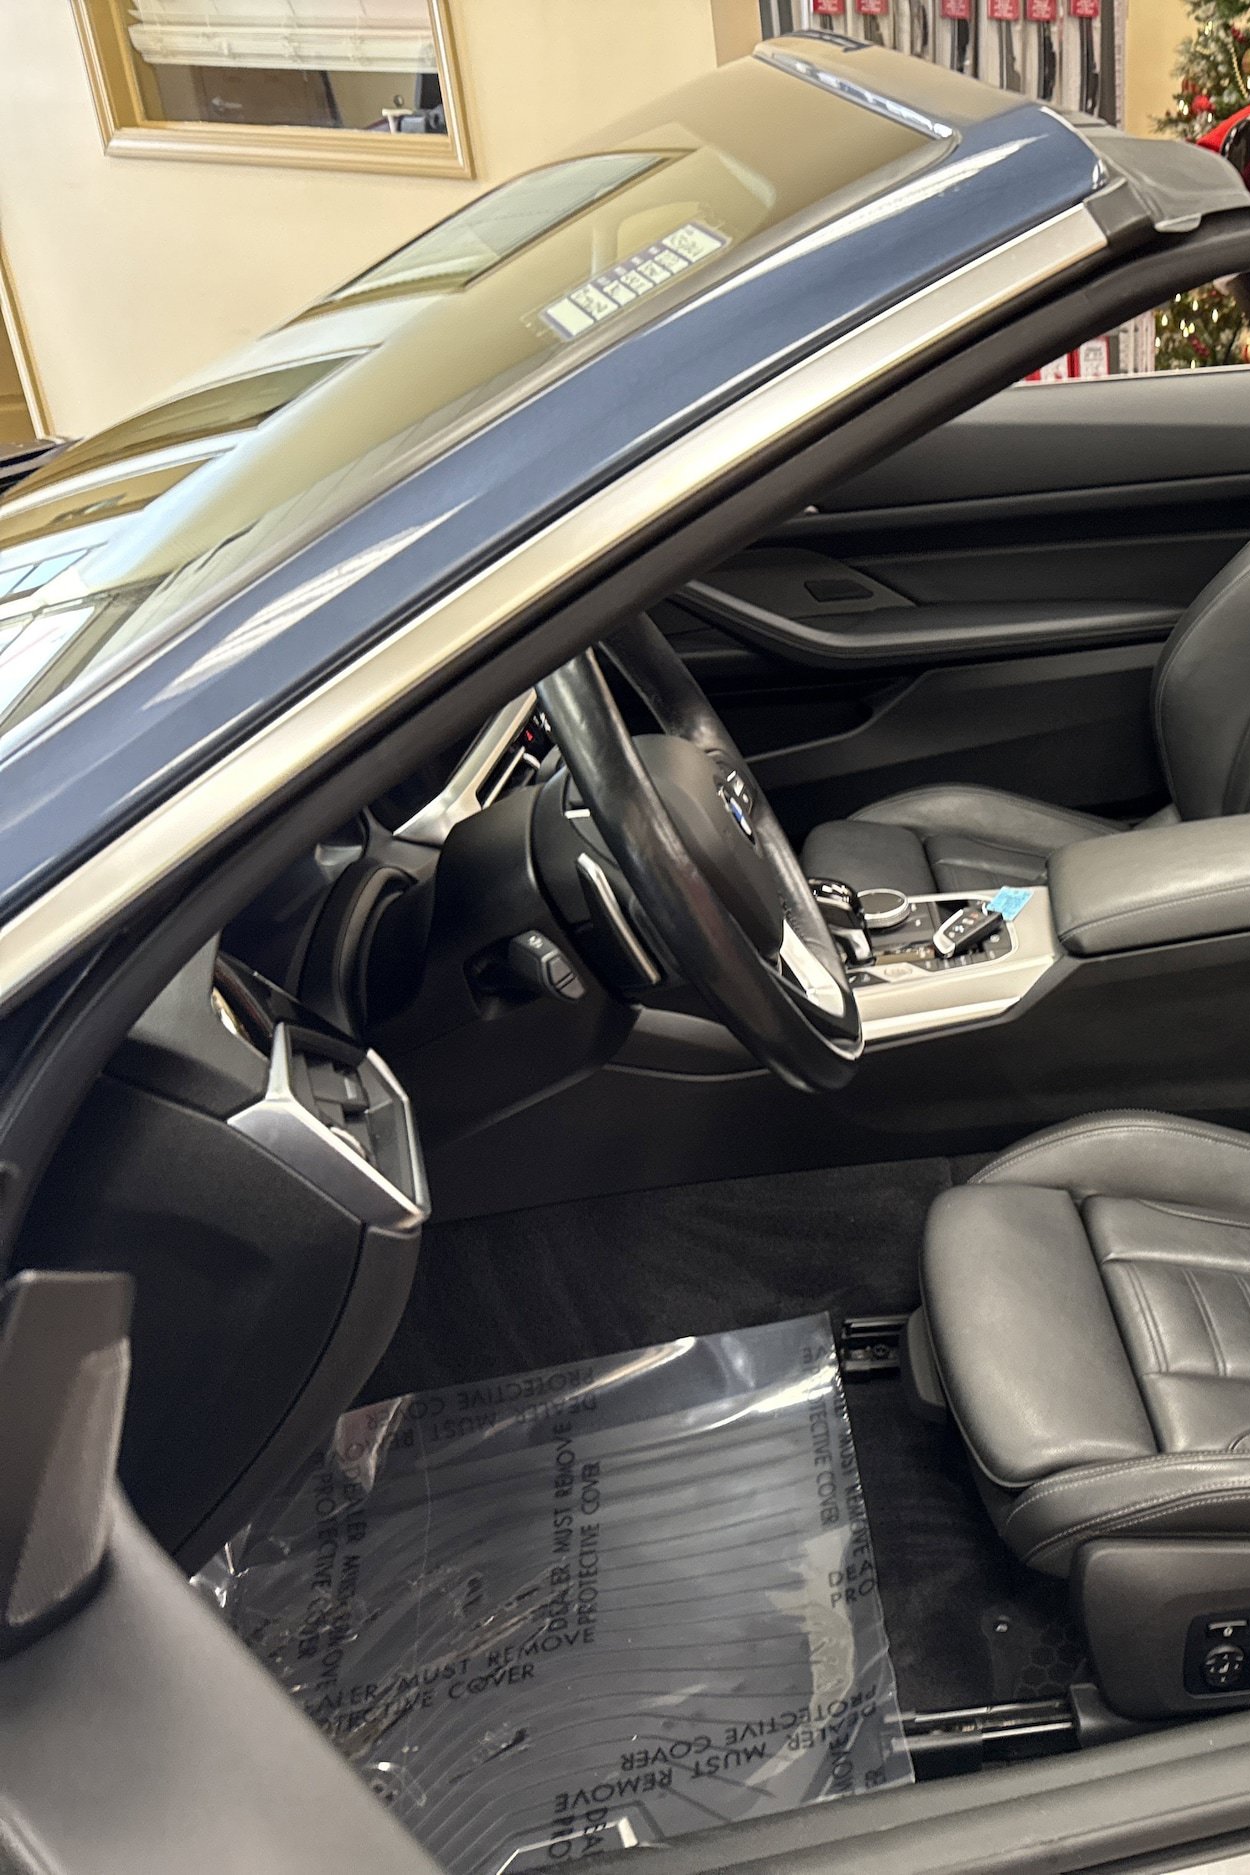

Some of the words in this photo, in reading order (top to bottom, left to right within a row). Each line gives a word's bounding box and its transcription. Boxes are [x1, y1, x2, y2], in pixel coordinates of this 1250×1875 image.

[457, 1367, 593, 1410] PROTECTIVE
[554, 1423, 576, 1498] REMOVE
[581, 1461, 601, 1516] COVER
[816, 1470, 840, 1527] COVER
[554, 1507, 573, 1553] MUST
[578, 1523, 600, 1626] PROTECTIVE
[400, 1659, 470, 1690] MUST
[488, 1628, 596, 1668] REMOVE
[450, 1664, 535, 1699] COVER
[726, 1685, 878, 1746] PROTECTIVE
[621, 1736, 711, 1772] COVER
[690, 1742, 766, 1779] MUST
[555, 1766, 673, 1813] REMOVE
